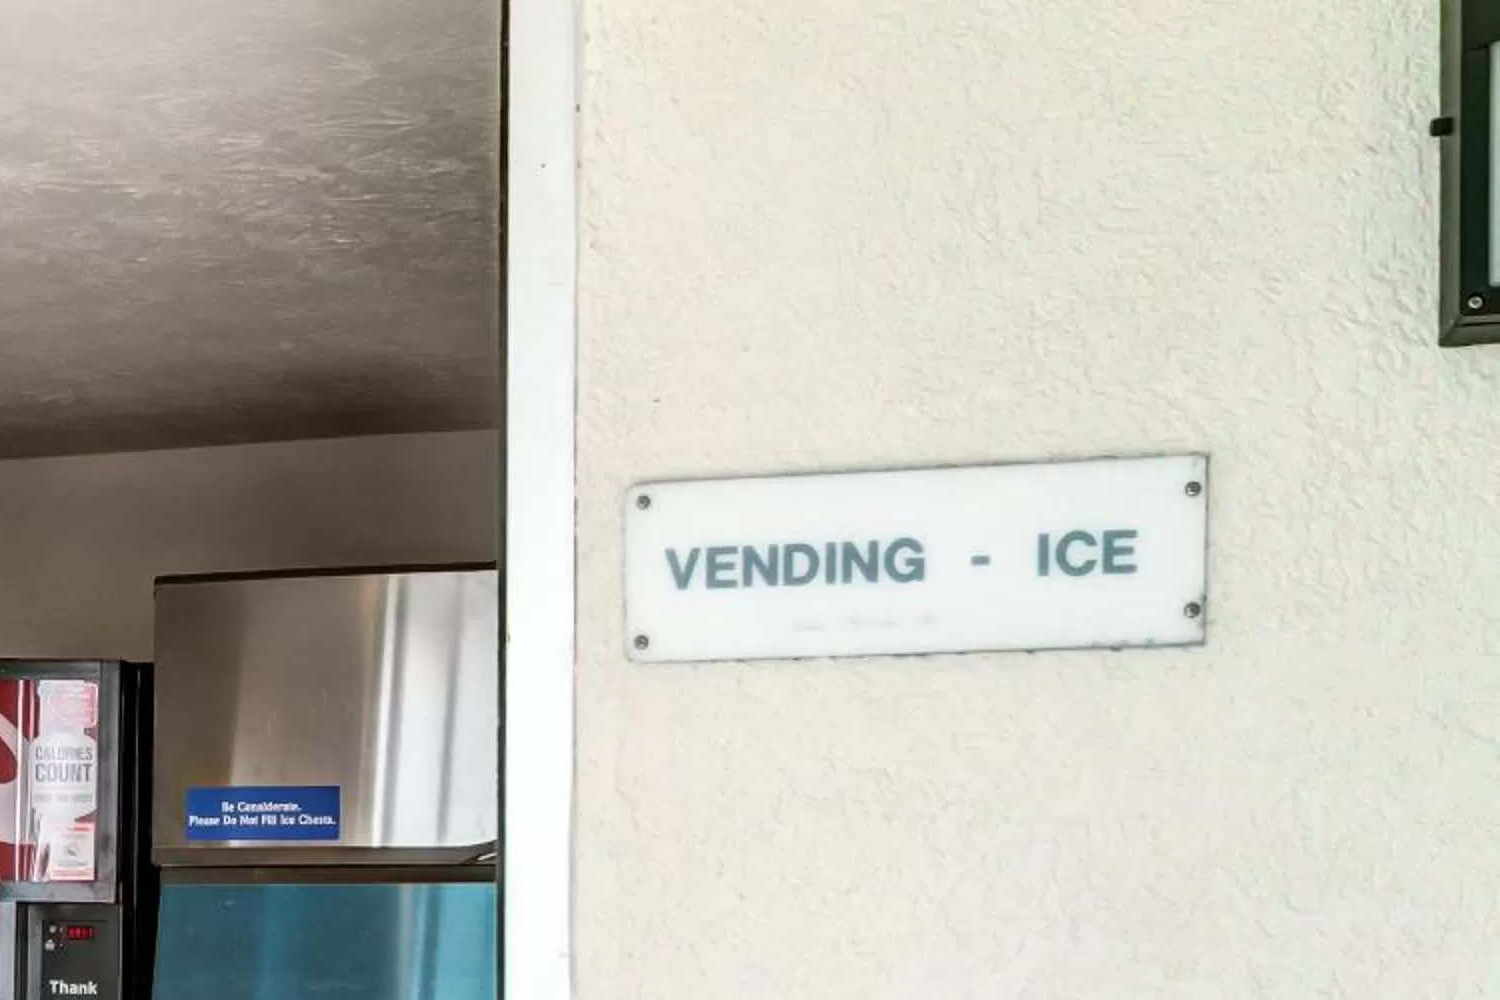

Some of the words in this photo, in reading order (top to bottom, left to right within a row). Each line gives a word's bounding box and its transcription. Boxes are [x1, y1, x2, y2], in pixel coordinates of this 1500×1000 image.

[664, 537, 925, 591] VENDING
[971, 554, 991, 566] -
[1037, 529, 1138, 577] ICE
[35, 746, 93, 761] CALORIES
[35, 763, 93, 783] COUNT
[221, 801, 235, 813] Be
[189, 815, 220, 826] Please
[223, 815, 237, 825] Do
[240, 815, 258, 825] Not
[261, 814, 277, 825] Fill
[280, 814, 295, 825] Ice
[49, 980, 98, 995] Thank
